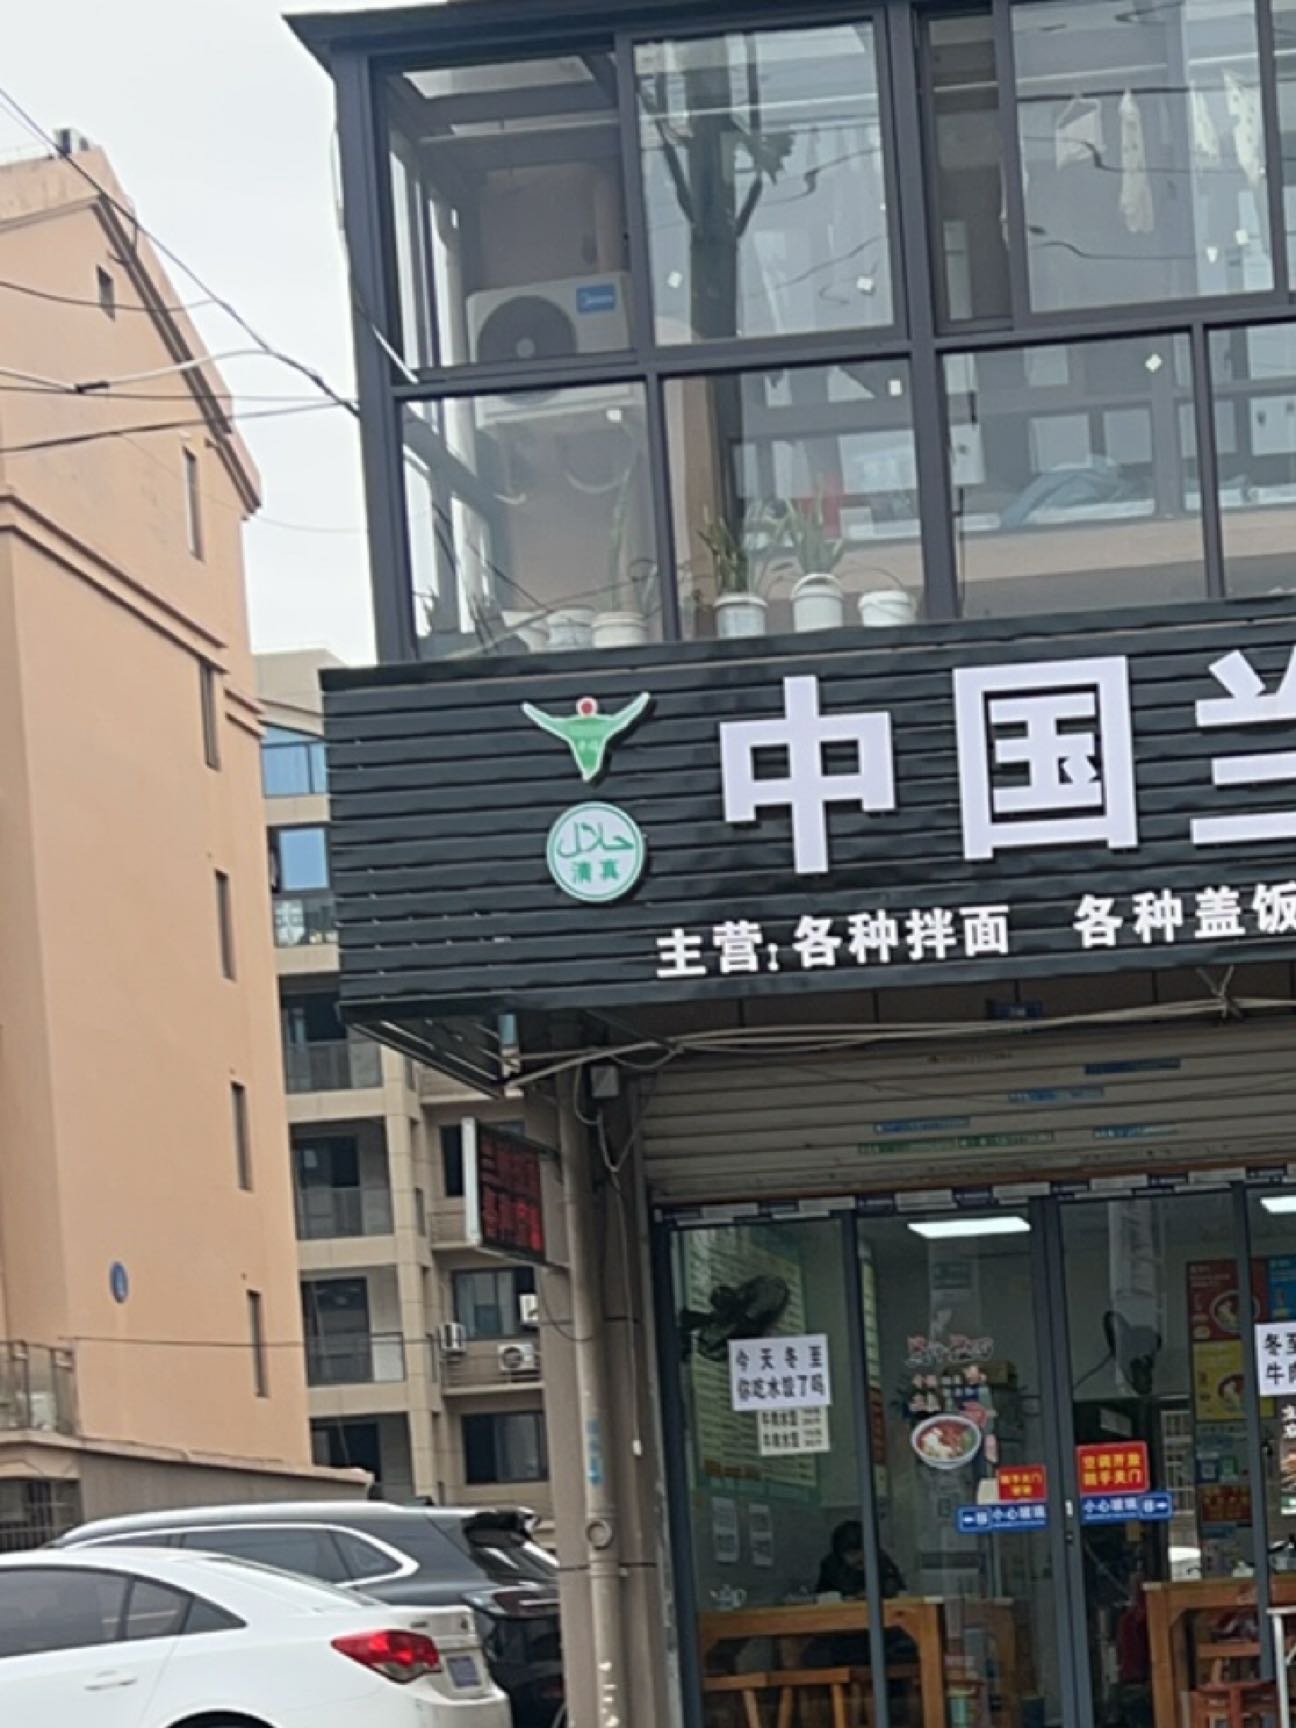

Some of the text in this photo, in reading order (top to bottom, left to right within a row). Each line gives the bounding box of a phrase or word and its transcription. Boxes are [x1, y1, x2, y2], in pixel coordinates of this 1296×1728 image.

[557, 821, 635, 858] حلال
[736, 1346, 822, 1372] 今天冬至
[738, 1374, 824, 1401] 你吃水饺了吗
